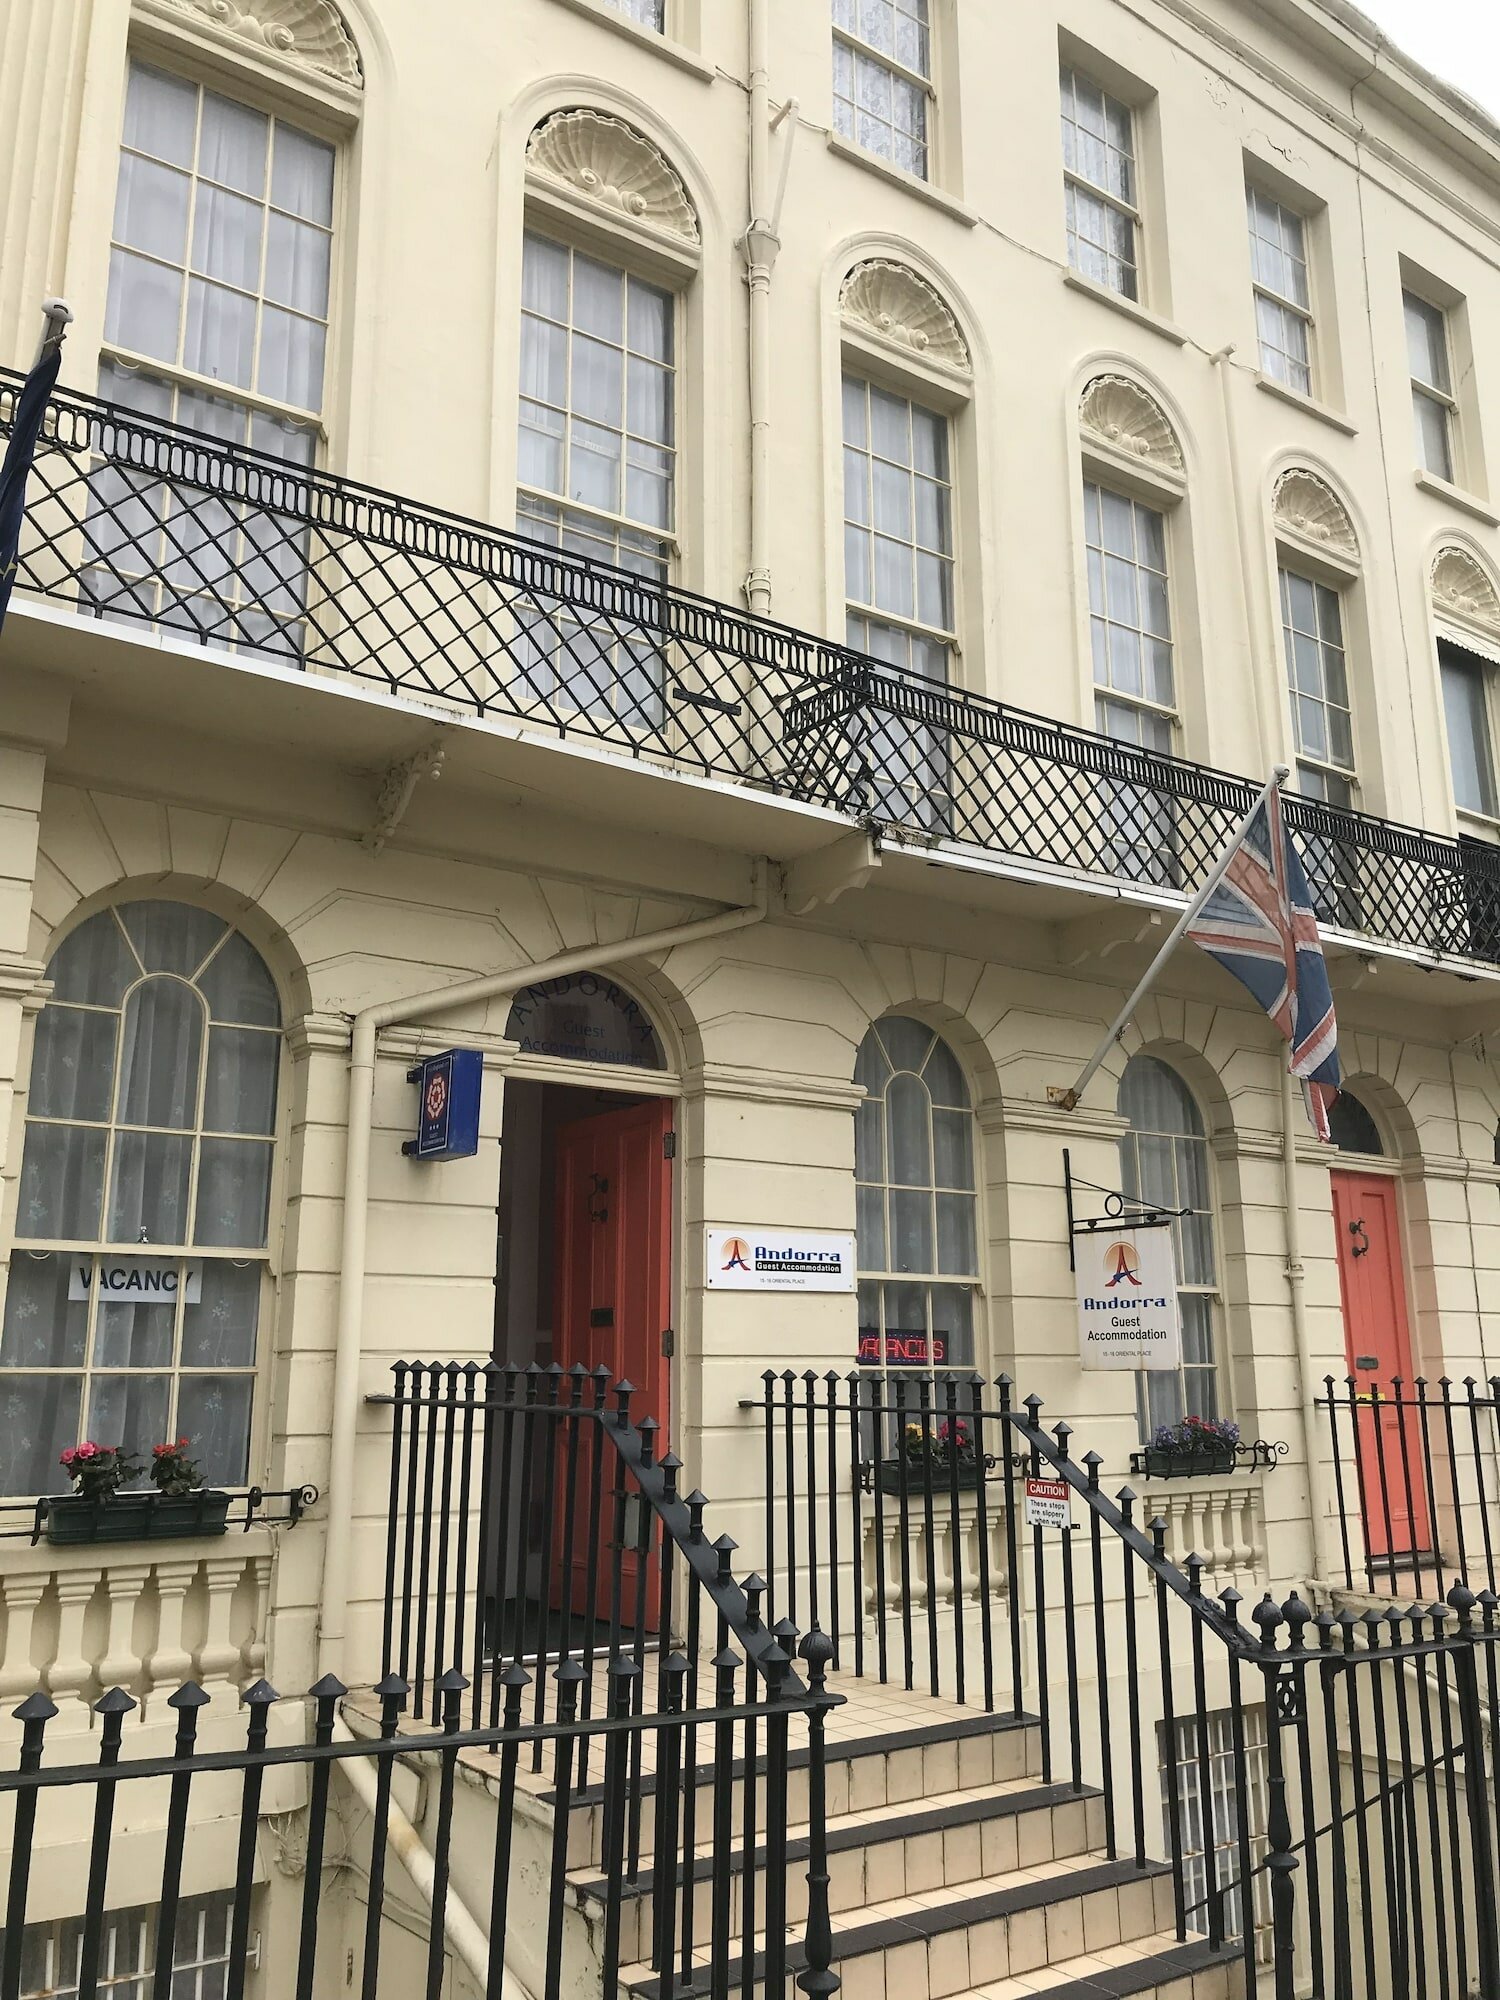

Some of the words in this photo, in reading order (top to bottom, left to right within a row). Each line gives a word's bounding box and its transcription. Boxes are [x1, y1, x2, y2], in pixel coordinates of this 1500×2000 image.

[512, 974, 653, 1043] ANDORRA
[563, 1020, 606, 1039] Guest
[755, 1246, 841, 1262] Andorra
[757, 1262, 780, 1271] Guest
[781, 1262, 840, 1273] Accommodation
[1084, 1296, 1167, 1310] Andorra
[1111, 1316, 1141, 1327] Guest
[1087, 1329, 1167, 1341] Accommodation
[1030, 1483, 1065, 1497] CAUTION
[1030, 1499, 1047, 1508] These
[1049, 1502, 1065, 1510] steps
[1042, 1510, 1064, 1519] slippery
